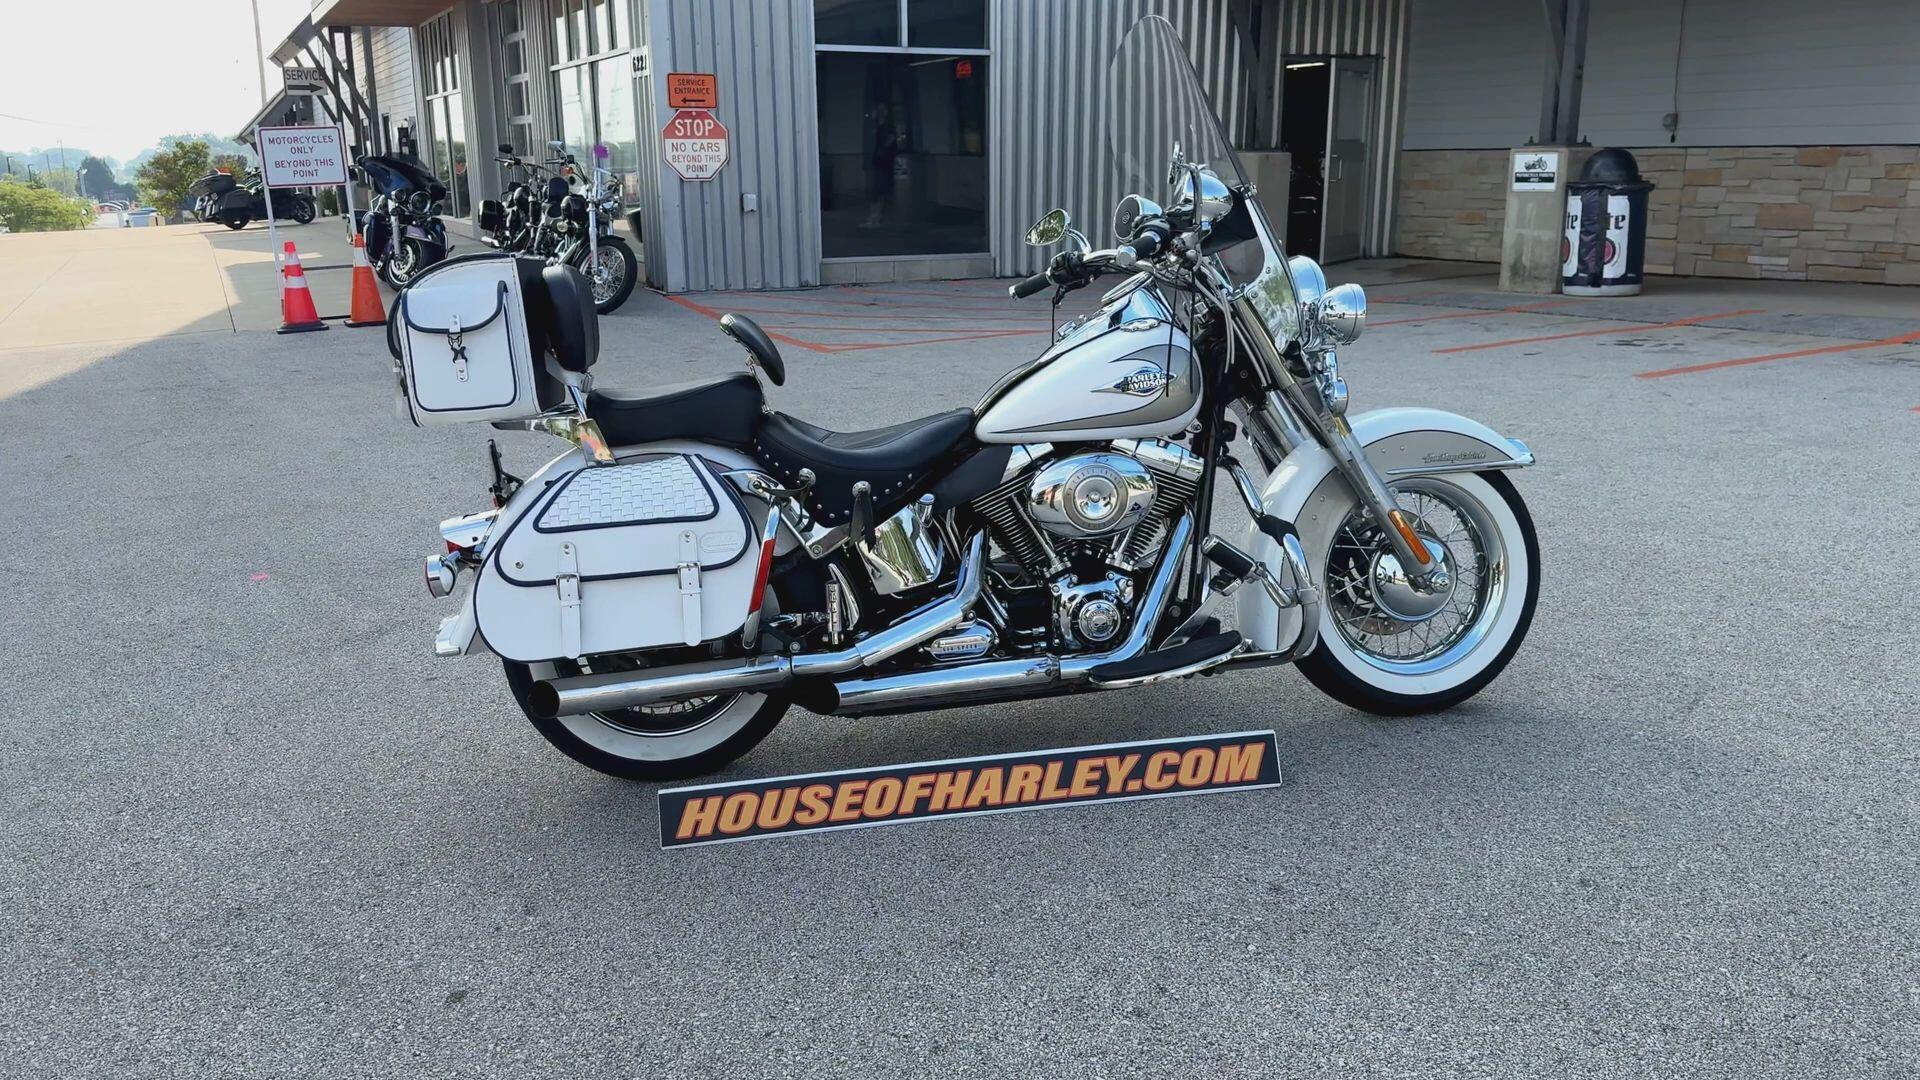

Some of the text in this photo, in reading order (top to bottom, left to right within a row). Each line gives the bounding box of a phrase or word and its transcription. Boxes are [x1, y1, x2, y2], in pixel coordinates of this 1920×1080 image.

[632, 54, 647, 73] 6221
[677, 79, 706, 87] SERVICE
[674, 119, 714, 137] STOP
[268, 135, 334, 145] MOTORCYCLES
[290, 146, 314, 155] ONLY
[671, 142, 720, 152] NO CARS
[274, 158, 335, 169] BEYOND THIS
[672, 154, 721, 164] BEYOND THIS
[293, 168, 320, 178] POINT
[686, 164, 708, 173] POINT
[1567, 212, 1578, 230] te
[1122, 378, 1167, 391] AVIDSON
[675, 741, 1266, 840] HOUSEOFHARLEY.COM
